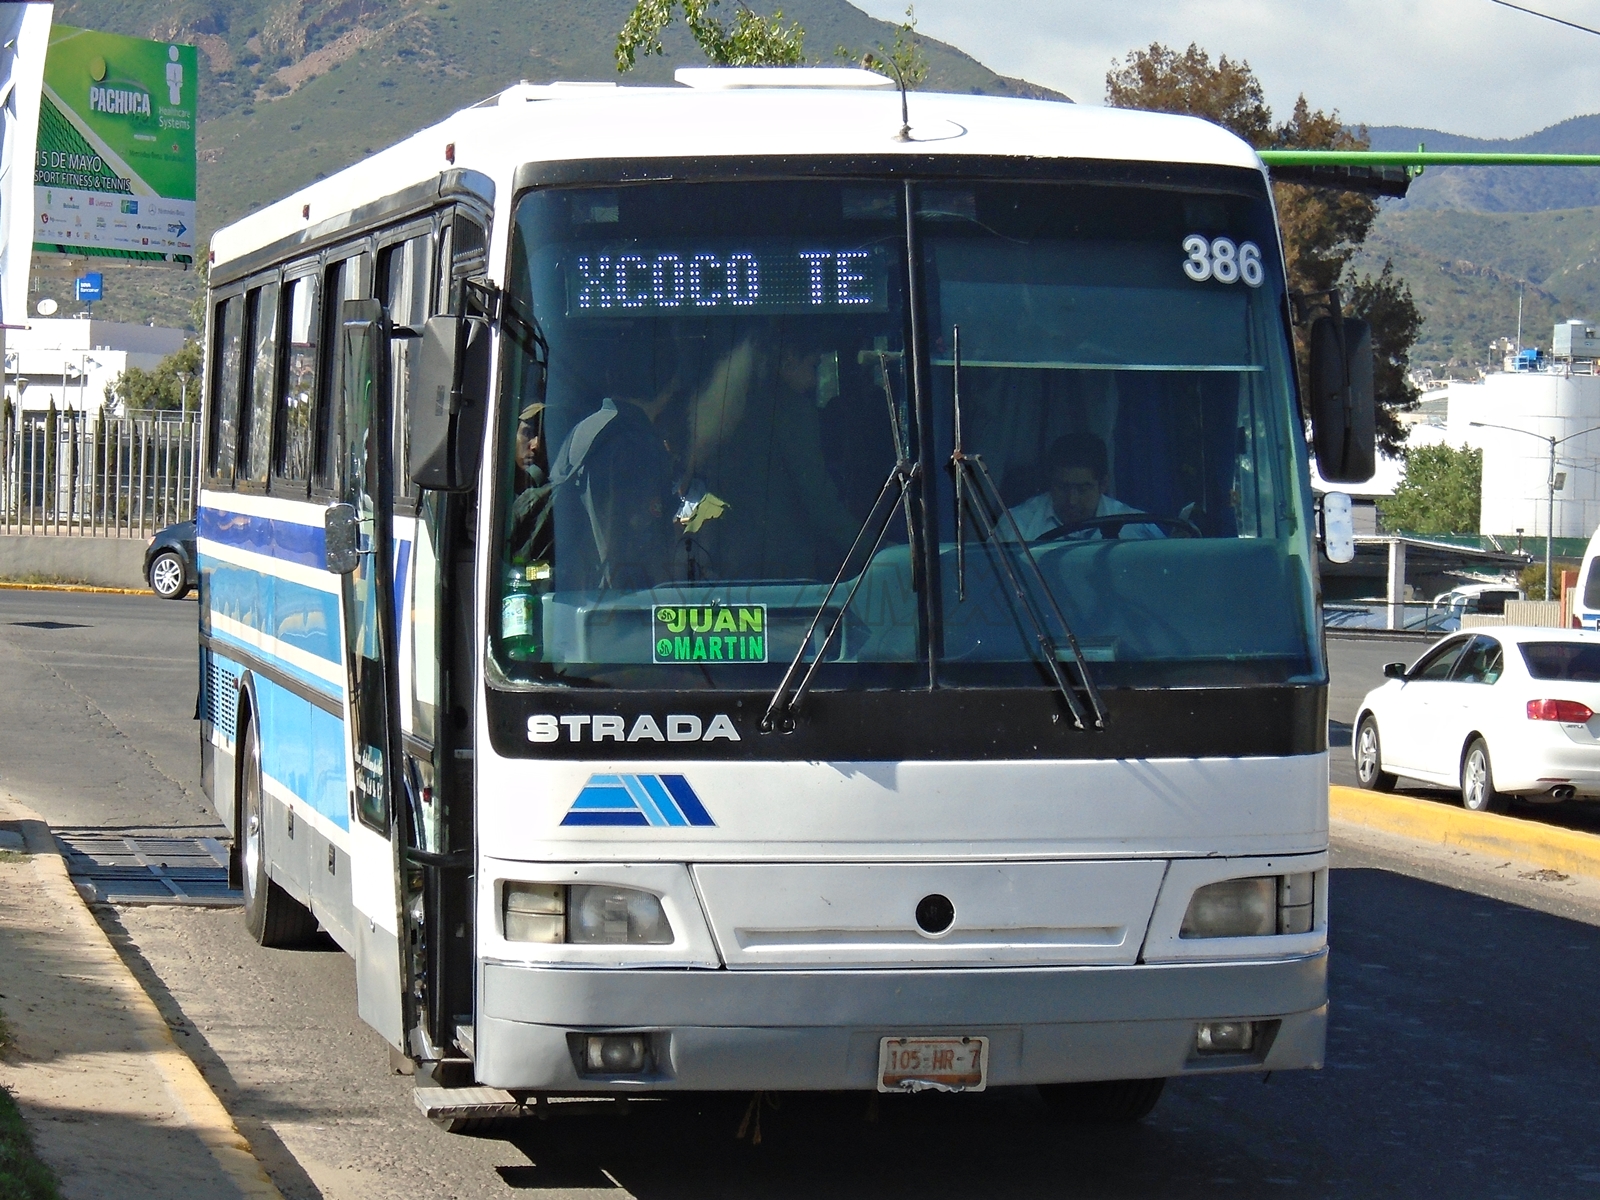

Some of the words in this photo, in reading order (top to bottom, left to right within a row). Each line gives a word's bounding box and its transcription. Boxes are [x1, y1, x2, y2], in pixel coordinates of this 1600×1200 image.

[90, 86, 151, 117] PACHUCA
[158, 116, 191, 130] Systems
[51, 151, 66, 169] DE
[68, 153, 102, 172] MAYO
[61, 172, 93, 188] FITNESS
[94, 176, 101, 188] &
[101, 176, 131, 191] TENNIS
[1182, 234, 1265, 288] 386
[799, 250, 870, 304] TE
[667, 608, 763, 633] JUAN
[674, 636, 763, 660] MARTIN
[527, 714, 741, 742] STRADA
